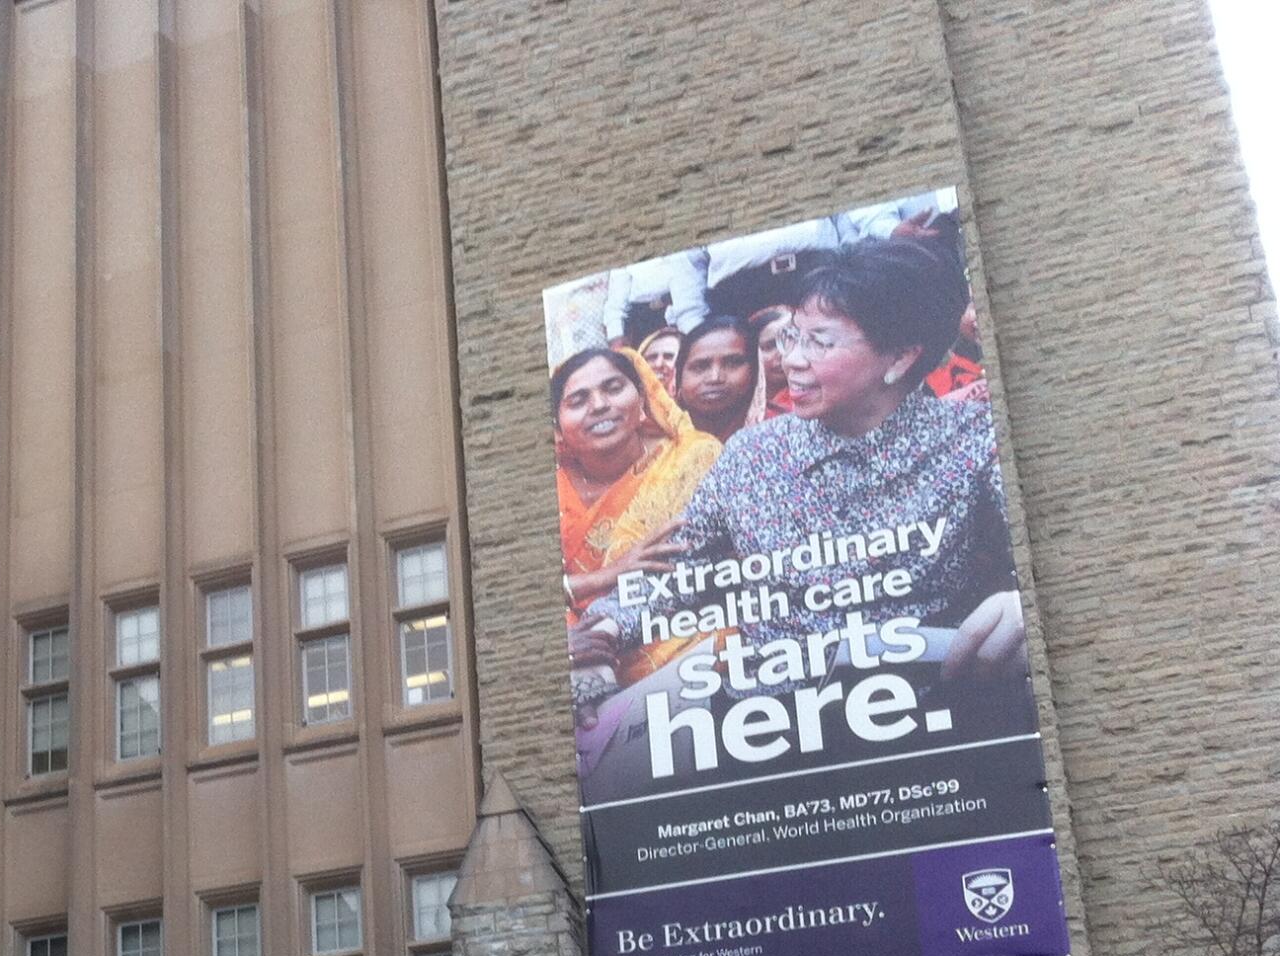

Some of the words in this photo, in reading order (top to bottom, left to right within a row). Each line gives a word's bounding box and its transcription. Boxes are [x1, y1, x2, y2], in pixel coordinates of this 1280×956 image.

[618, 516, 948, 607] Extraordinary
[641, 590, 791, 645] health
[804, 567, 913, 612] care
[678, 611, 927, 699] starts
[645, 673, 953, 779] here.
[637, 829, 770, 862] Director-General,
[773, 820, 820, 840] World
[823, 813, 877, 833] Health
[880, 797, 988, 824] Organization
[658, 814, 730, 840] Margaret
[734, 808, 780, 826] Chan,
[784, 799, 836, 819] BA'73,
[839, 789, 895, 811] MD'77,
[898, 778, 961, 801] DSc'99
[616, 929, 655, 955] Be
[662, 900, 886, 948] Extraordinary.
[955, 922, 1030, 943] Western
